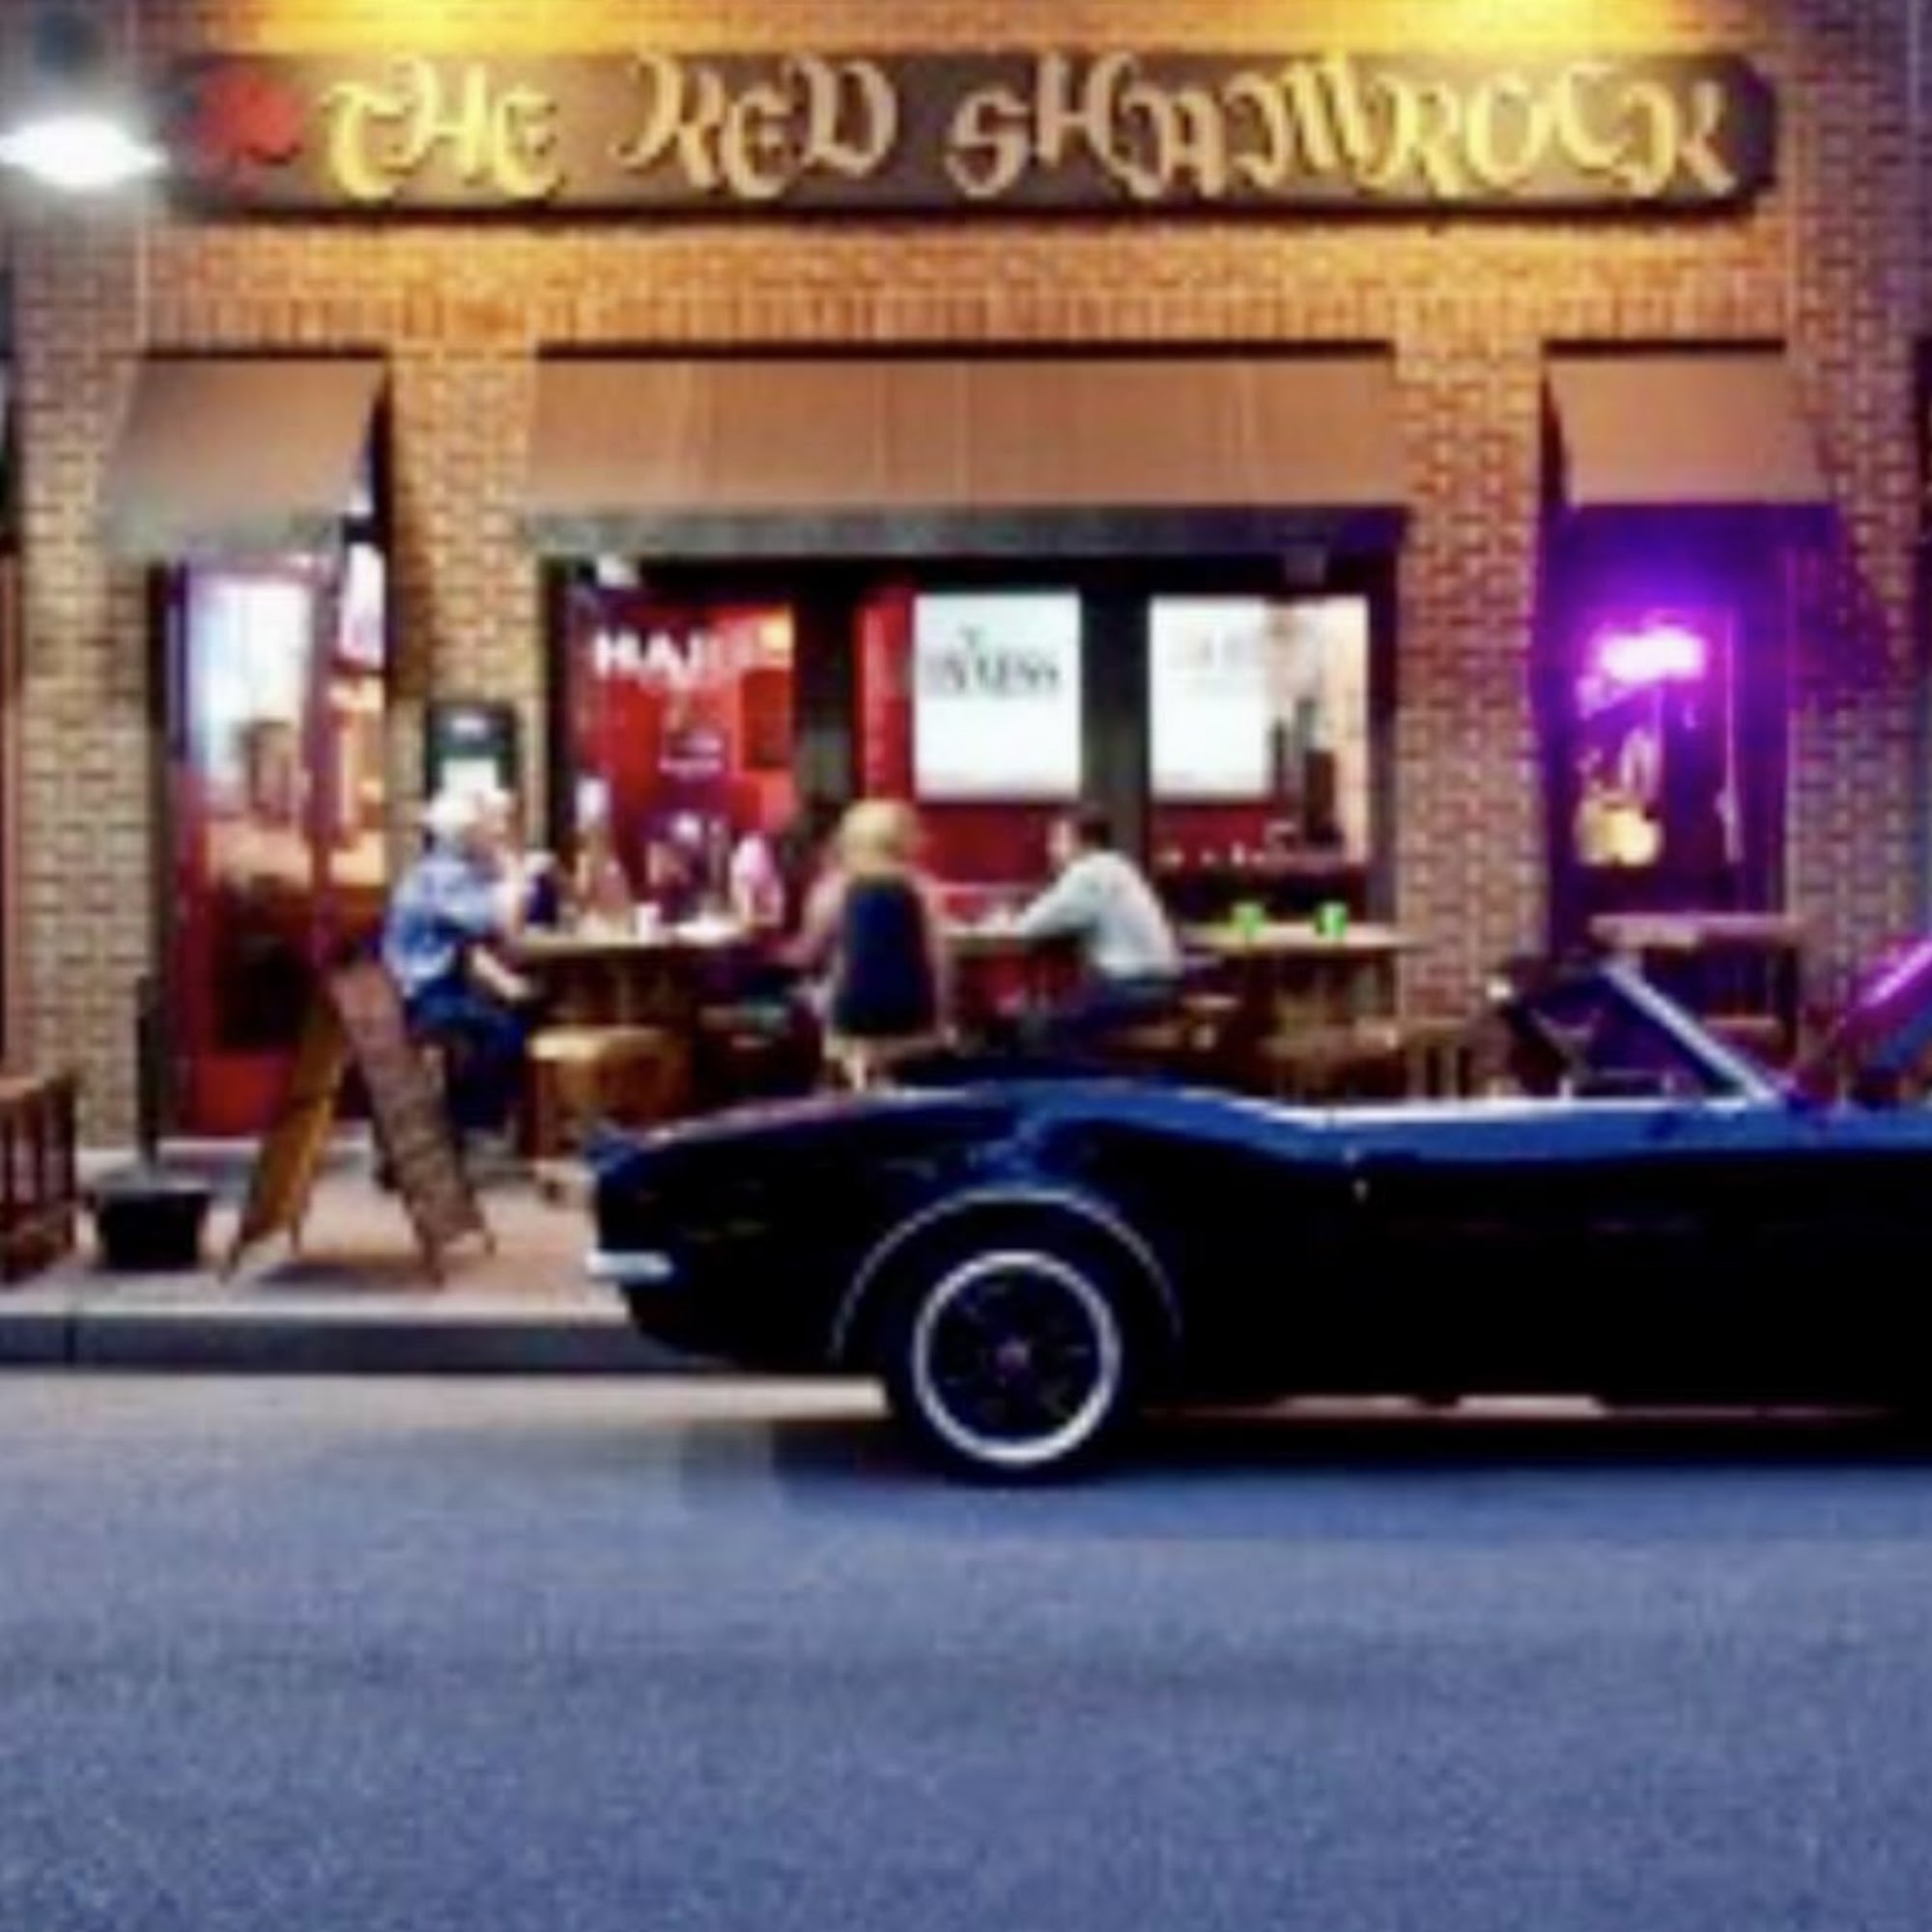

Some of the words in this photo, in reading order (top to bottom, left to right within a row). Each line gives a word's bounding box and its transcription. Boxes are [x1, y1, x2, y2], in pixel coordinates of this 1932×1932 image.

[321, 51, 566, 201] THE
[611, 50, 898, 199] RED
[944, 50, 1736, 199] SHAMROCK
